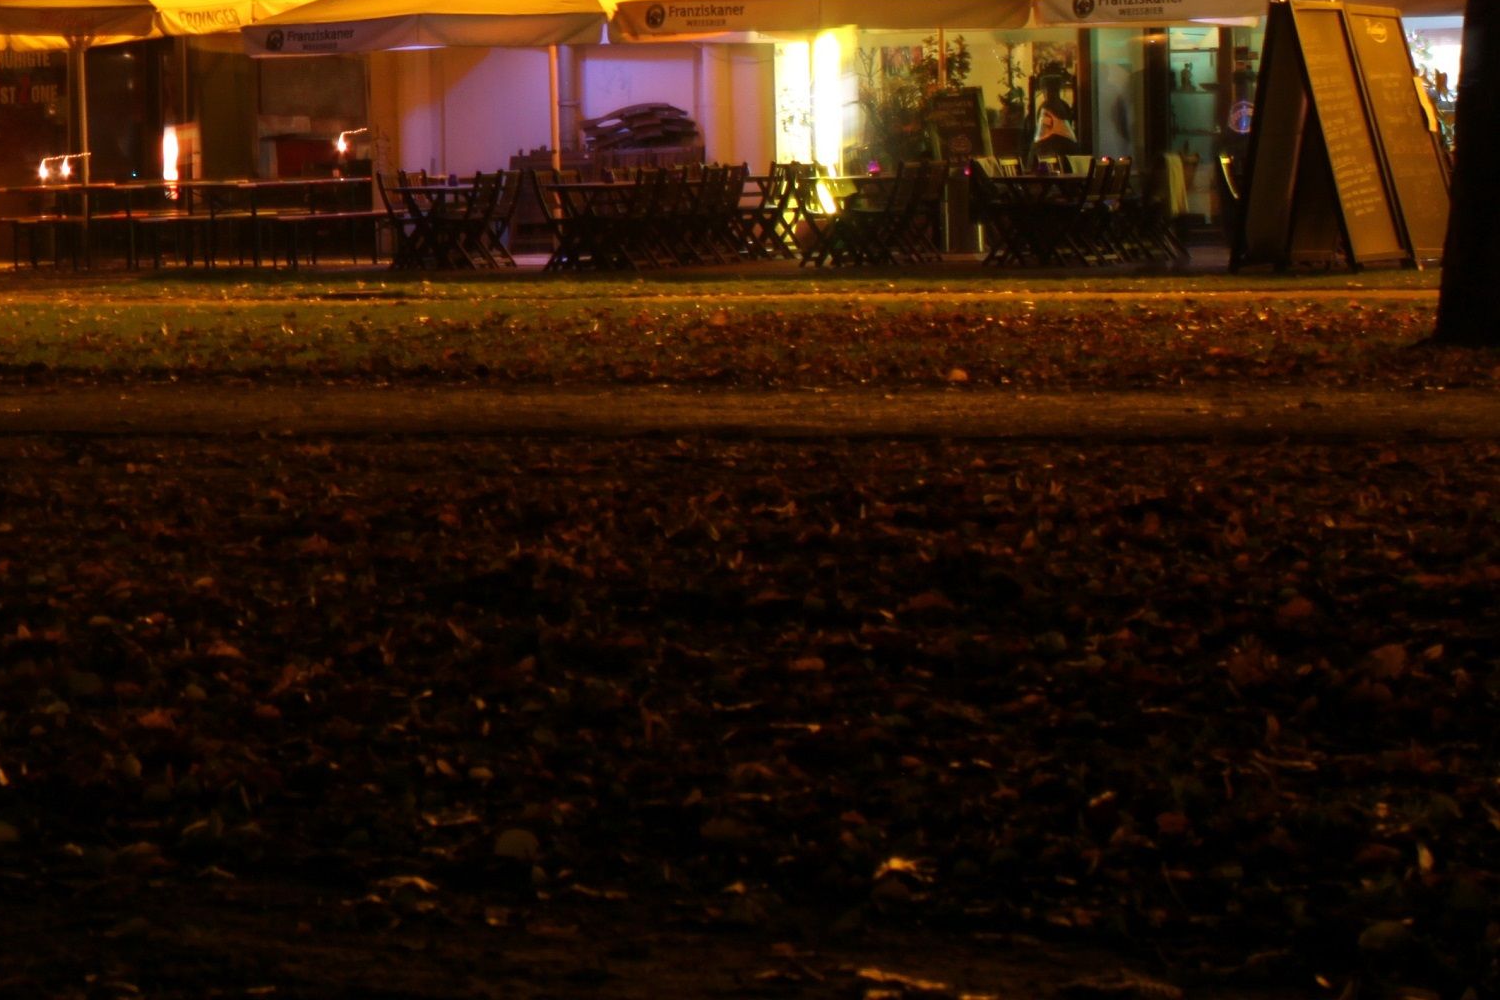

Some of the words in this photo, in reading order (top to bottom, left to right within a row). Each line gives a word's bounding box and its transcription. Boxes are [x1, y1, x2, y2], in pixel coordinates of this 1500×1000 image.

[668, 4, 745, 17] Franziskaner
[178, 8, 241, 28] ERDINGER
[287, 29, 355, 42] Franziskaner
